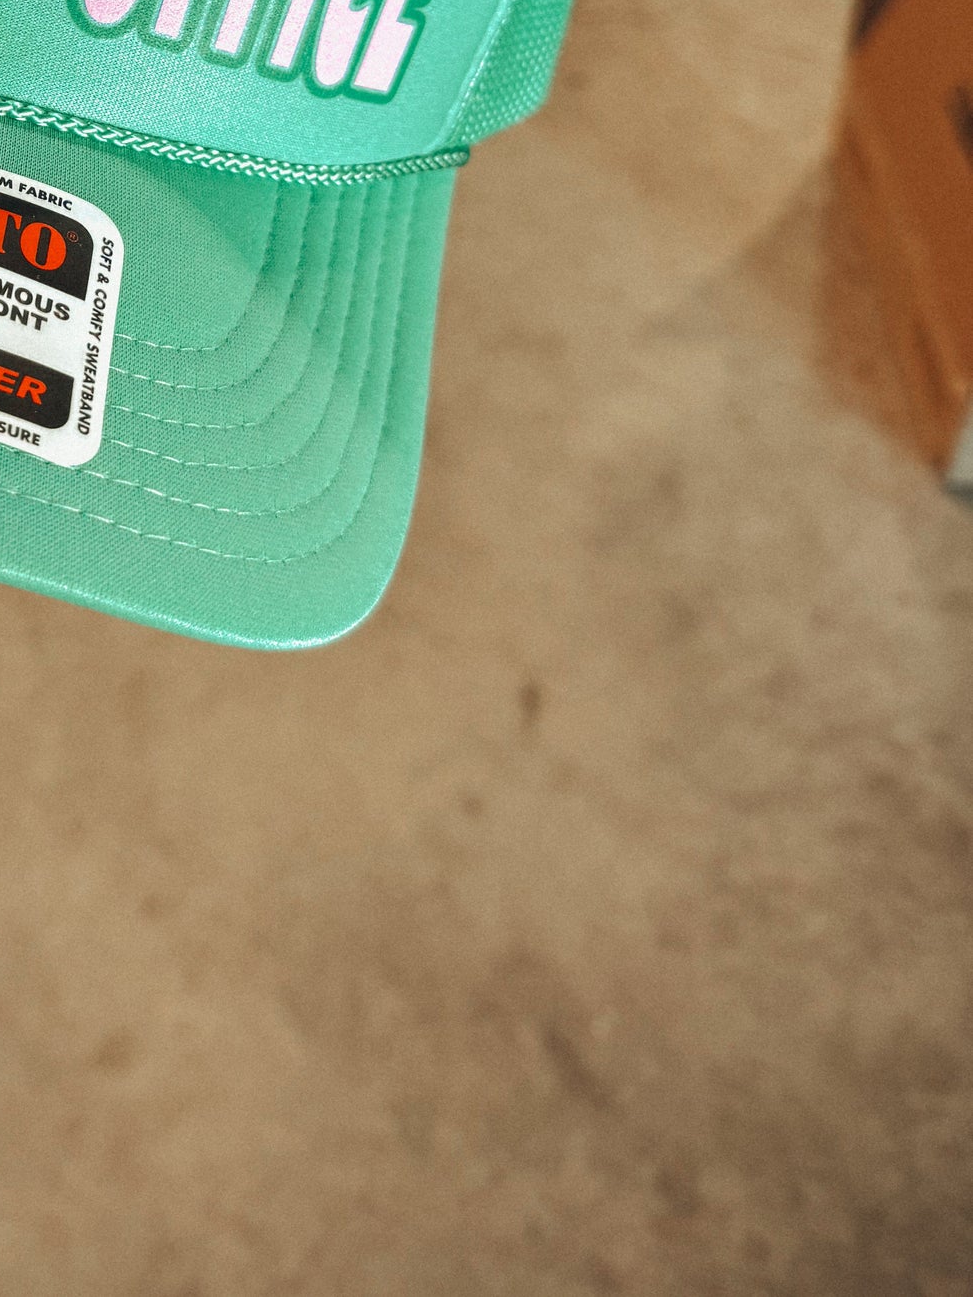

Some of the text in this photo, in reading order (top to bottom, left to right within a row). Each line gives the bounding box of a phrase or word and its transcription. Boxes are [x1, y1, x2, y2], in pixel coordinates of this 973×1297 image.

[18, 182, 73, 211] FABRIC
[77, 236, 114, 436] SOFT & COMFY SWEATBAND
